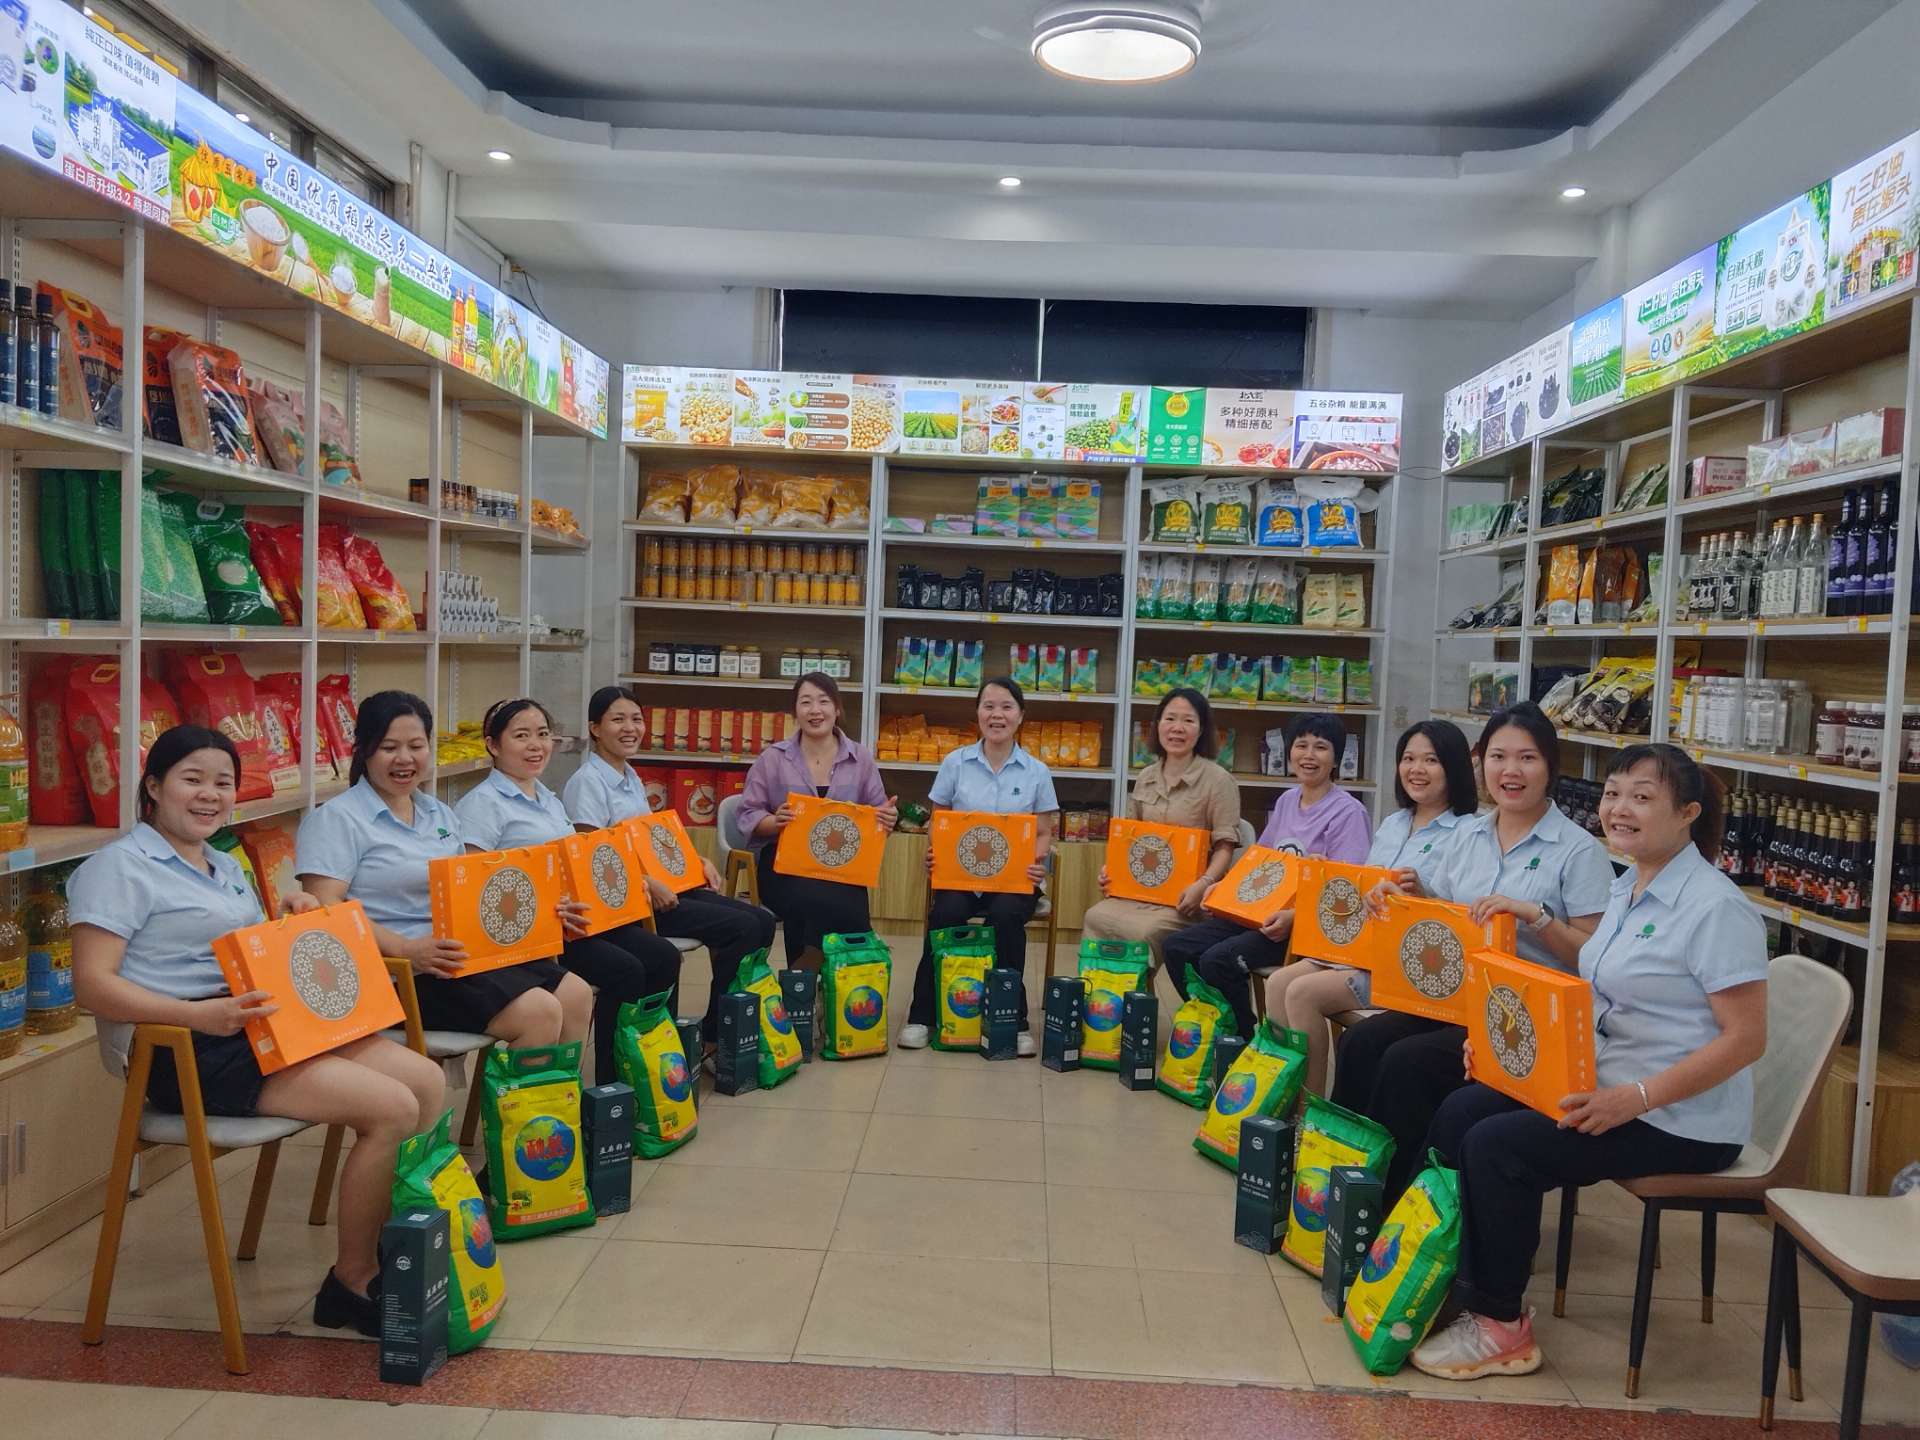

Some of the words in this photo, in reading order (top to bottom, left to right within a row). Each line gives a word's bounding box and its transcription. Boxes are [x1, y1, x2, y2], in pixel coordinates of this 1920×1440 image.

[1309, 399, 1347, 409] 五谷杂粮
[1349, 400, 1388, 410] 能量满满
[1219, 406, 1280, 418] 多种好原料
[1224, 419, 1273, 430] 精细搭配
